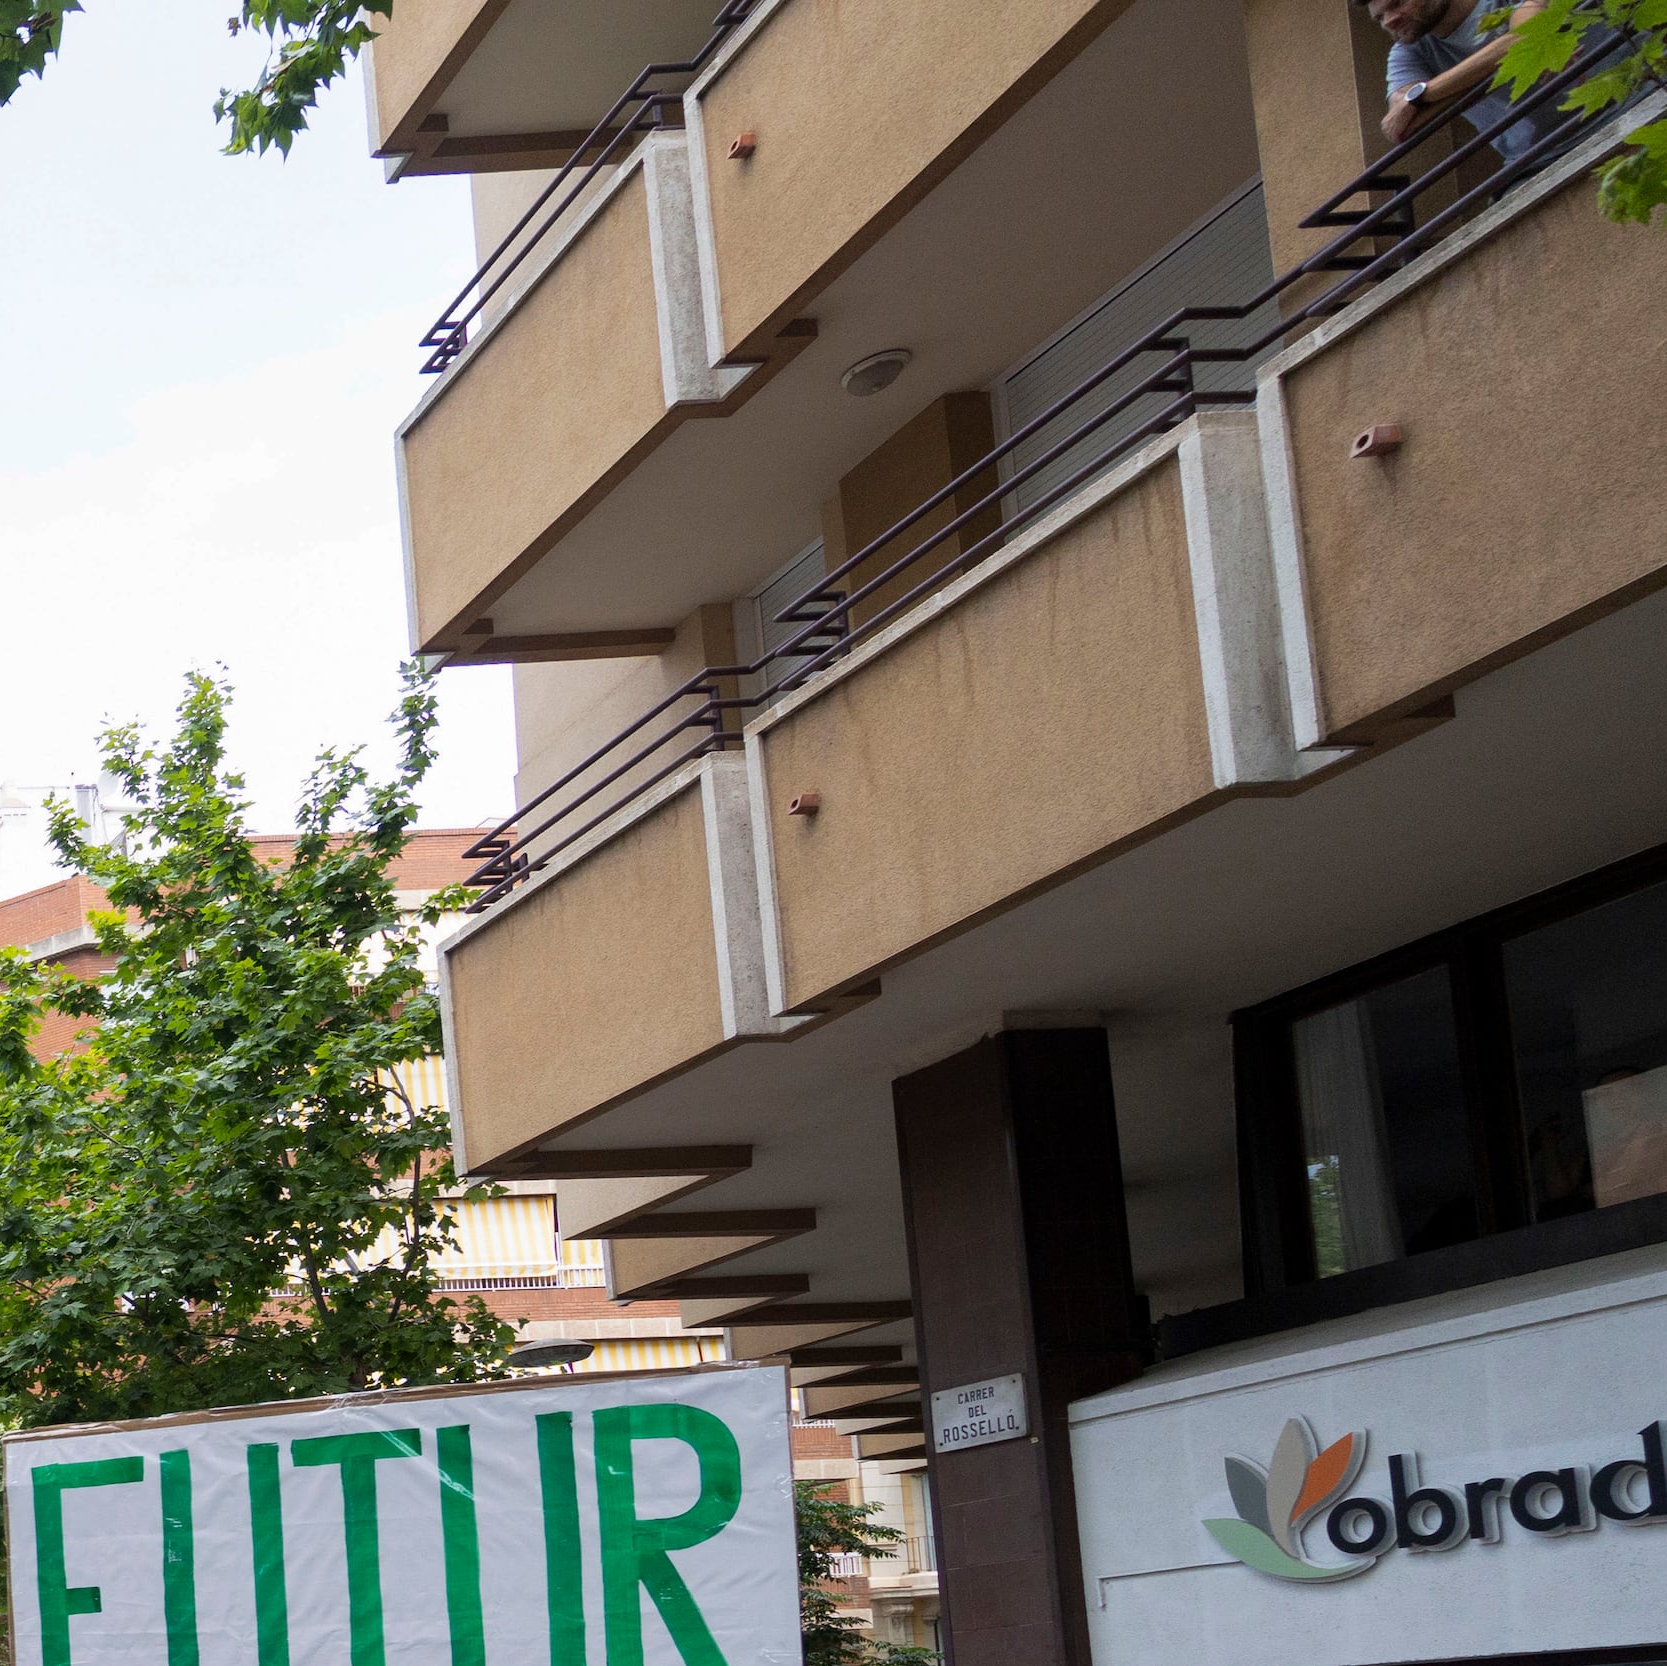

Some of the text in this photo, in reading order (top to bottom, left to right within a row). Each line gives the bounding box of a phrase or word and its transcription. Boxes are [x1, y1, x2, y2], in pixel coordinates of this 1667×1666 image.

[957, 1386, 995, 1405] CARRER
[968, 1405, 988, 1418] DEL
[943, 1409, 1015, 1444] ROSSELLÓ
[1326, 1419, 1667, 1555] obrad
